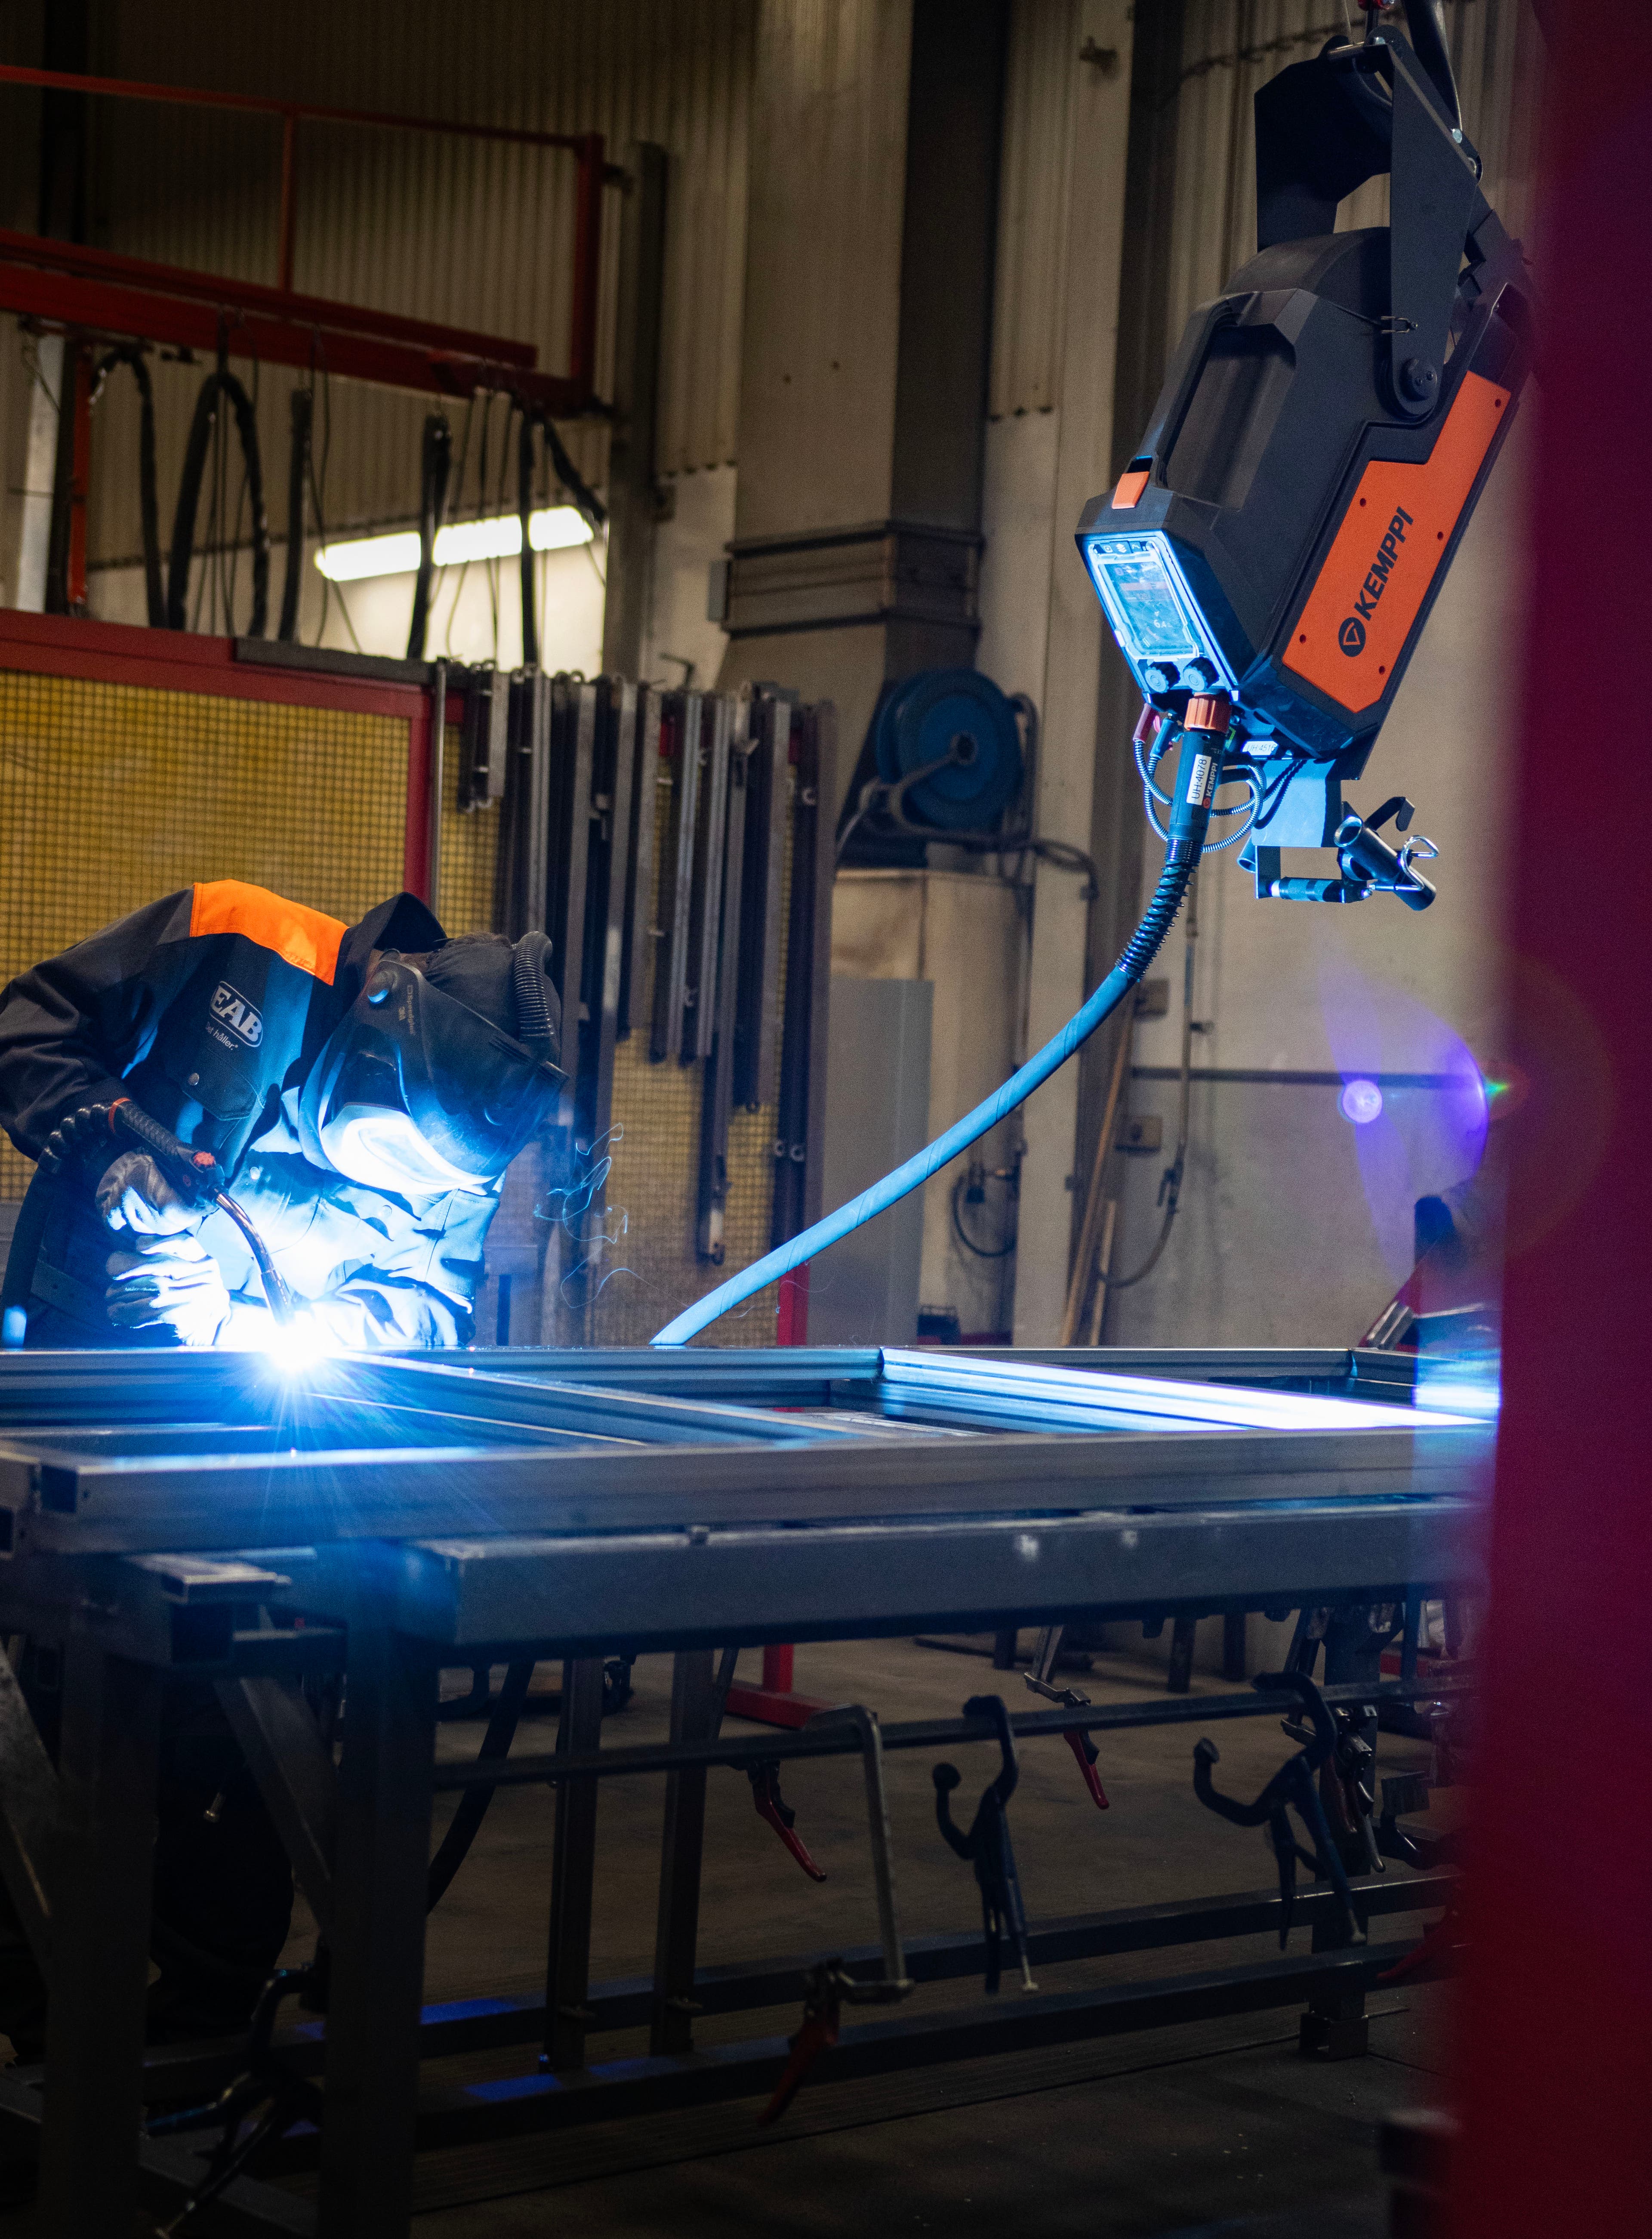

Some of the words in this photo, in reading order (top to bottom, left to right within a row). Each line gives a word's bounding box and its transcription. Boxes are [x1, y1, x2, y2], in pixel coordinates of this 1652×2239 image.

[1354, 506, 1414, 621] KEMPPI
[1247, 744, 1276, 752] UH:4516
[1191, 759, 1207, 800] UH:4078
[1206, 762, 1218, 797] KEMPPI
[210, 985, 262, 1042] EAB
